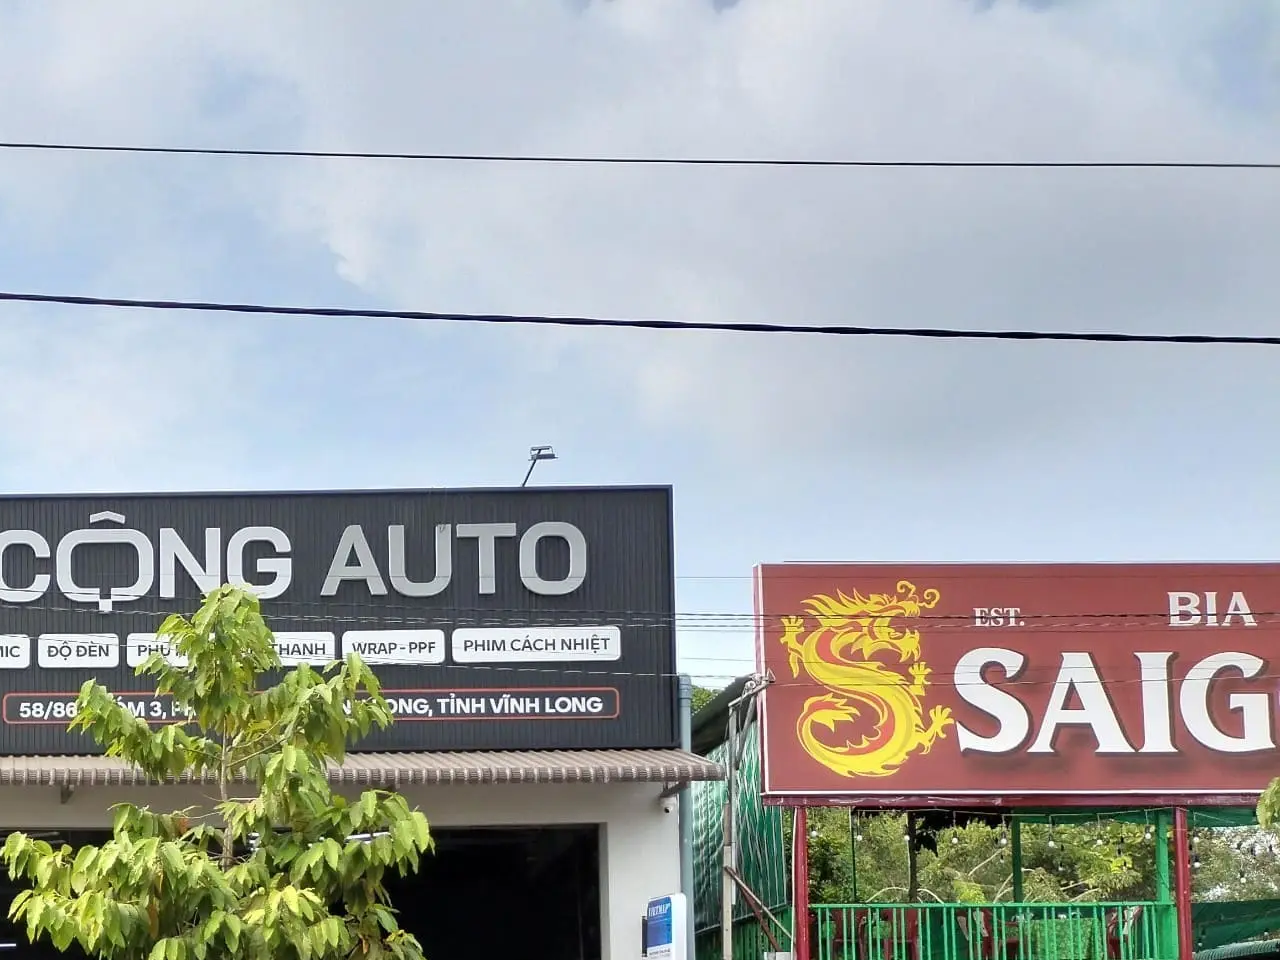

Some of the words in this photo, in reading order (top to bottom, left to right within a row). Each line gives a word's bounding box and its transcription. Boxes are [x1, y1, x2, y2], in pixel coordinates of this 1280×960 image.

[321, 521, 588, 597] AUTO
[973, 607, 1025, 627] EST.
[1166, 591, 1258, 628] BIA
[47, 640, 72, 660] ĐỘ
[75, 640, 110, 657] ĐÈN
[352, 641, 397, 655] WRAP
[409, 641, 436, 654] PPF
[463, 638, 505, 652] PHIM
[510, 634, 556, 652] CÁCH
[560, 634, 610, 654] NHIỆT
[371, 698, 433, 717] ONG,
[437, 692, 481, 714] TỈNH
[489, 694, 540, 713] VĨNH
[545, 696, 603, 714] LONG
